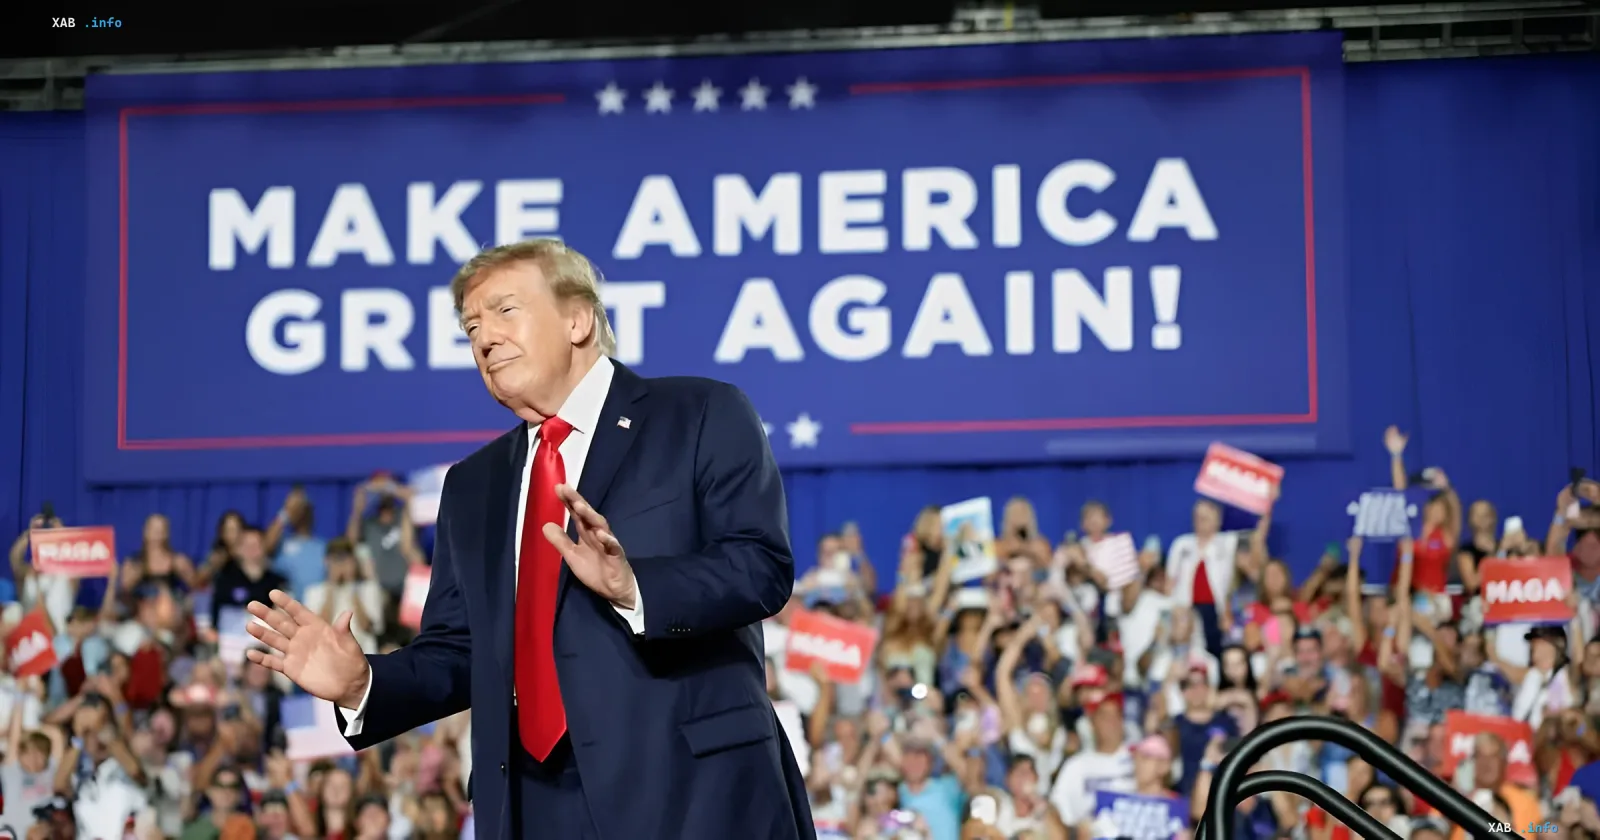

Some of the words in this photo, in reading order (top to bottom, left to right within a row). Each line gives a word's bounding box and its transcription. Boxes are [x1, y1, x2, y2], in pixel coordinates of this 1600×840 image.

[208, 178, 564, 271] MAKE
[613, 157, 1219, 259] AMERICA
[245, 279, 667, 376] GRET
[714, 264, 1183, 364] AGAIN!
